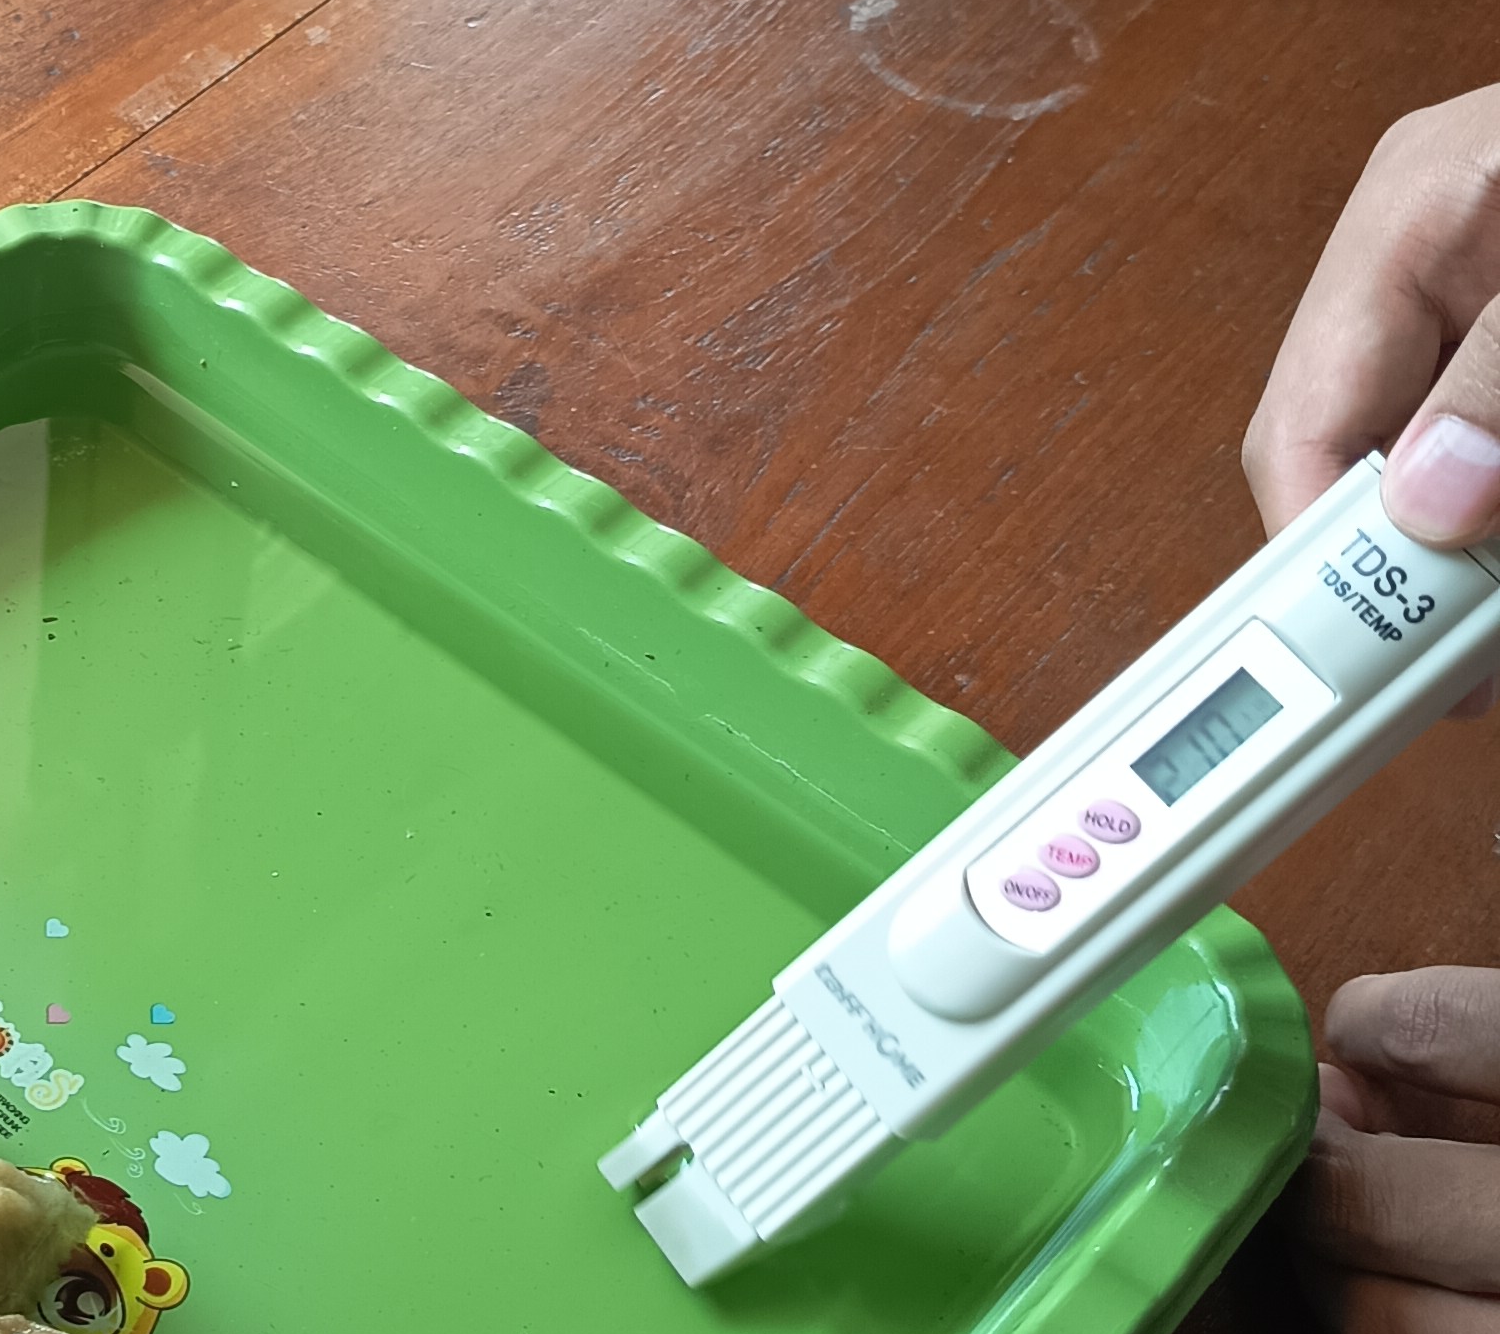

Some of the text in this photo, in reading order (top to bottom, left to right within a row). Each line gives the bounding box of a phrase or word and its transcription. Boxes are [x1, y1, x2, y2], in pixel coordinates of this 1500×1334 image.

[1316, 560, 1403, 642] TDS/TEMP
[1340, 527, 1436, 624] TDS-3
[1083, 809, 1132, 834] HOLD
[1047, 843, 1094, 868] TEMP
